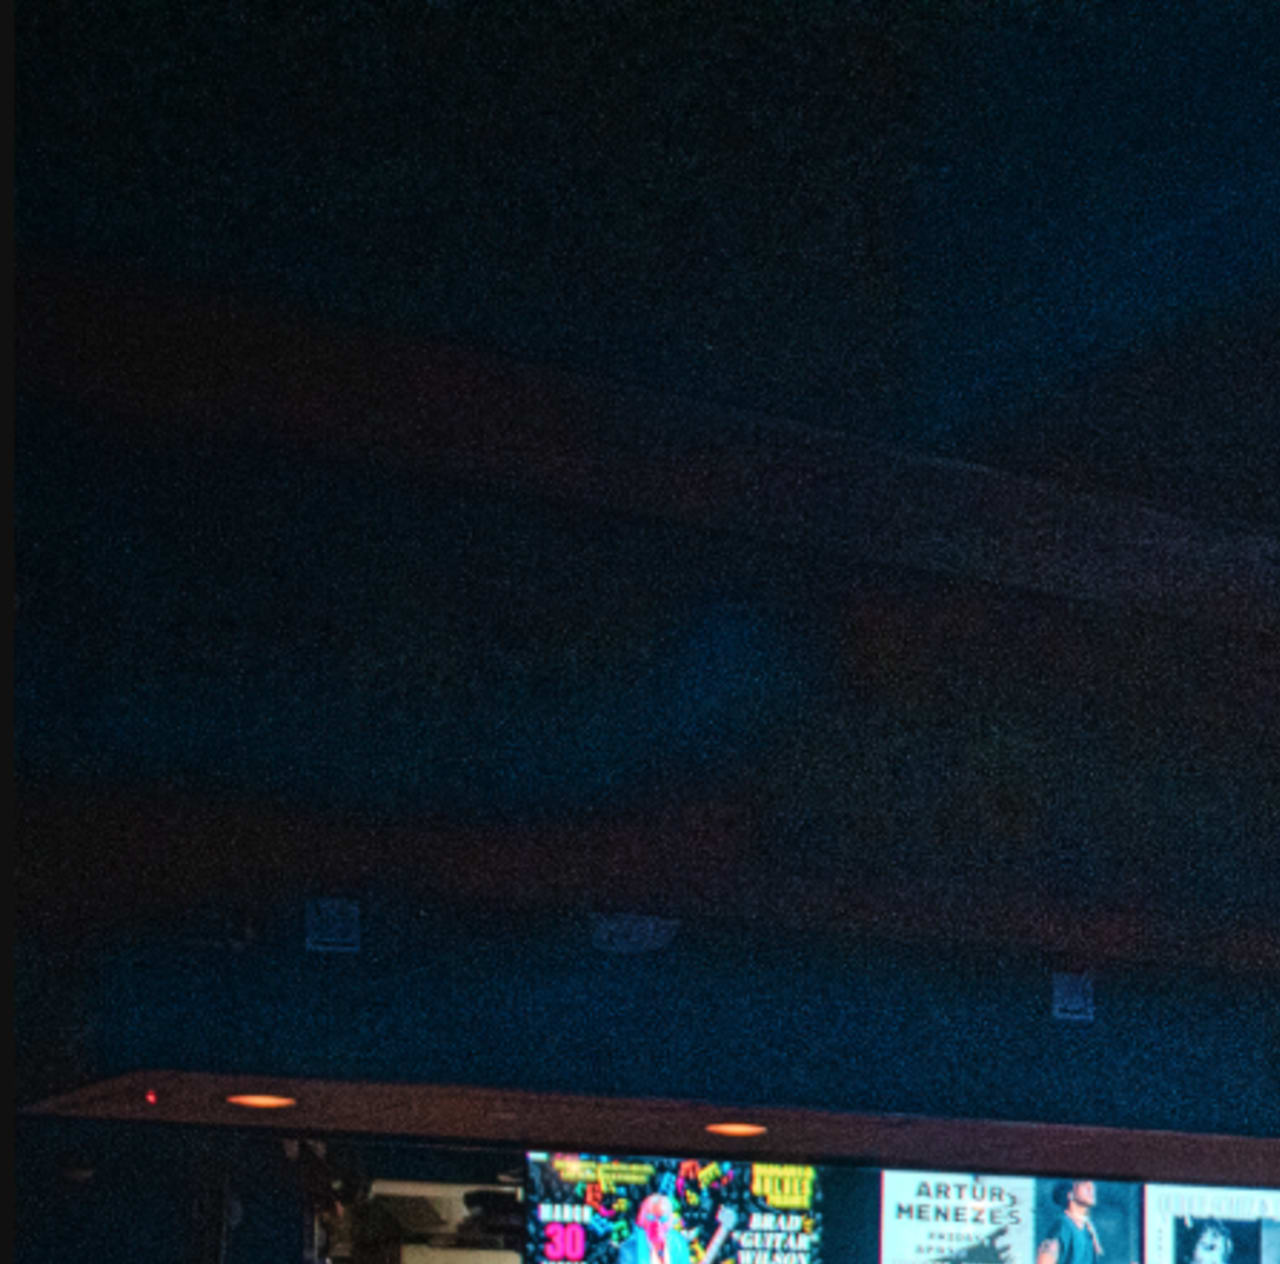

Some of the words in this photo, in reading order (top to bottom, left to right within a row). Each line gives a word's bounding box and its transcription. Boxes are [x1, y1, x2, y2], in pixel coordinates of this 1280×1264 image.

[748, 1211, 804, 1230] BRAD
[896, 1203, 1022, 1225] MENEZES
[544, 1221, 586, 1262] 30
